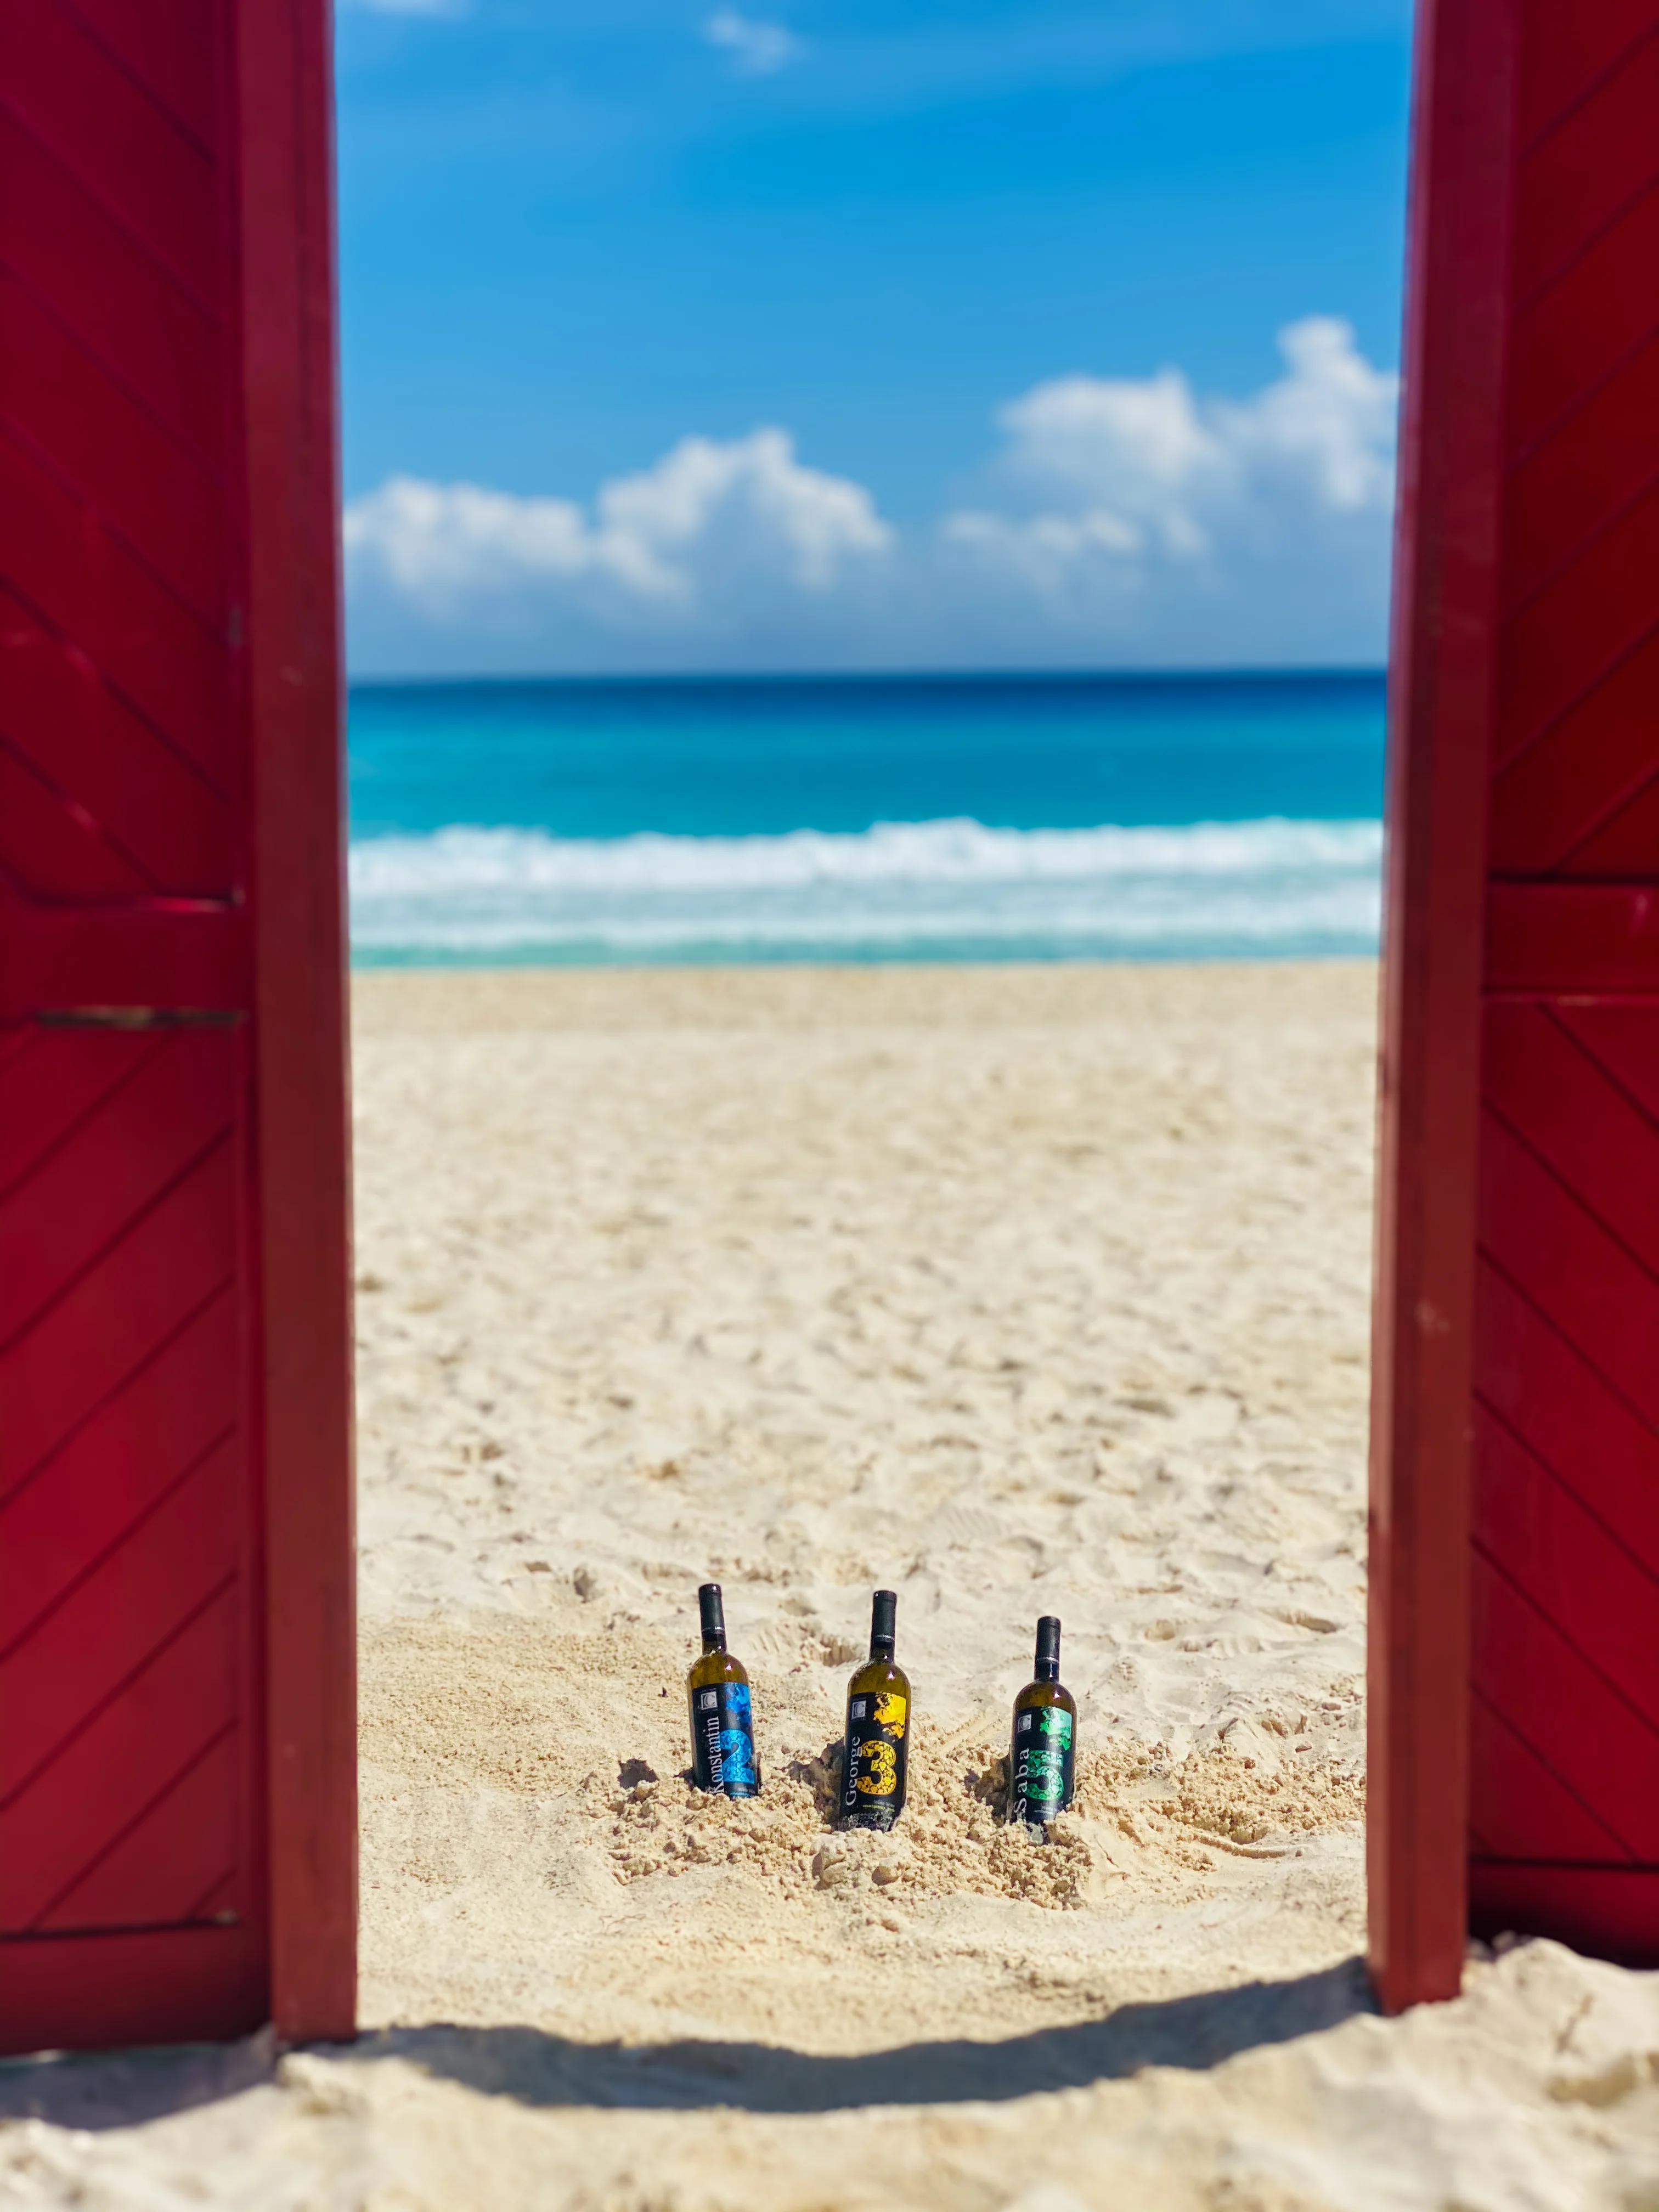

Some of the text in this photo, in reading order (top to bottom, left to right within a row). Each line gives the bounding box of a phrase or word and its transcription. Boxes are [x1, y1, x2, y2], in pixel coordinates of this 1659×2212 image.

[703, 1716, 725, 1794] Konstantin
[719, 1729, 755, 1784] 2
[845, 1735, 863, 1806] George
[856, 1740, 897, 1796] 3
[1015, 1747, 1030, 1814] Saba
[1024, 1750, 1064, 1801] 5
